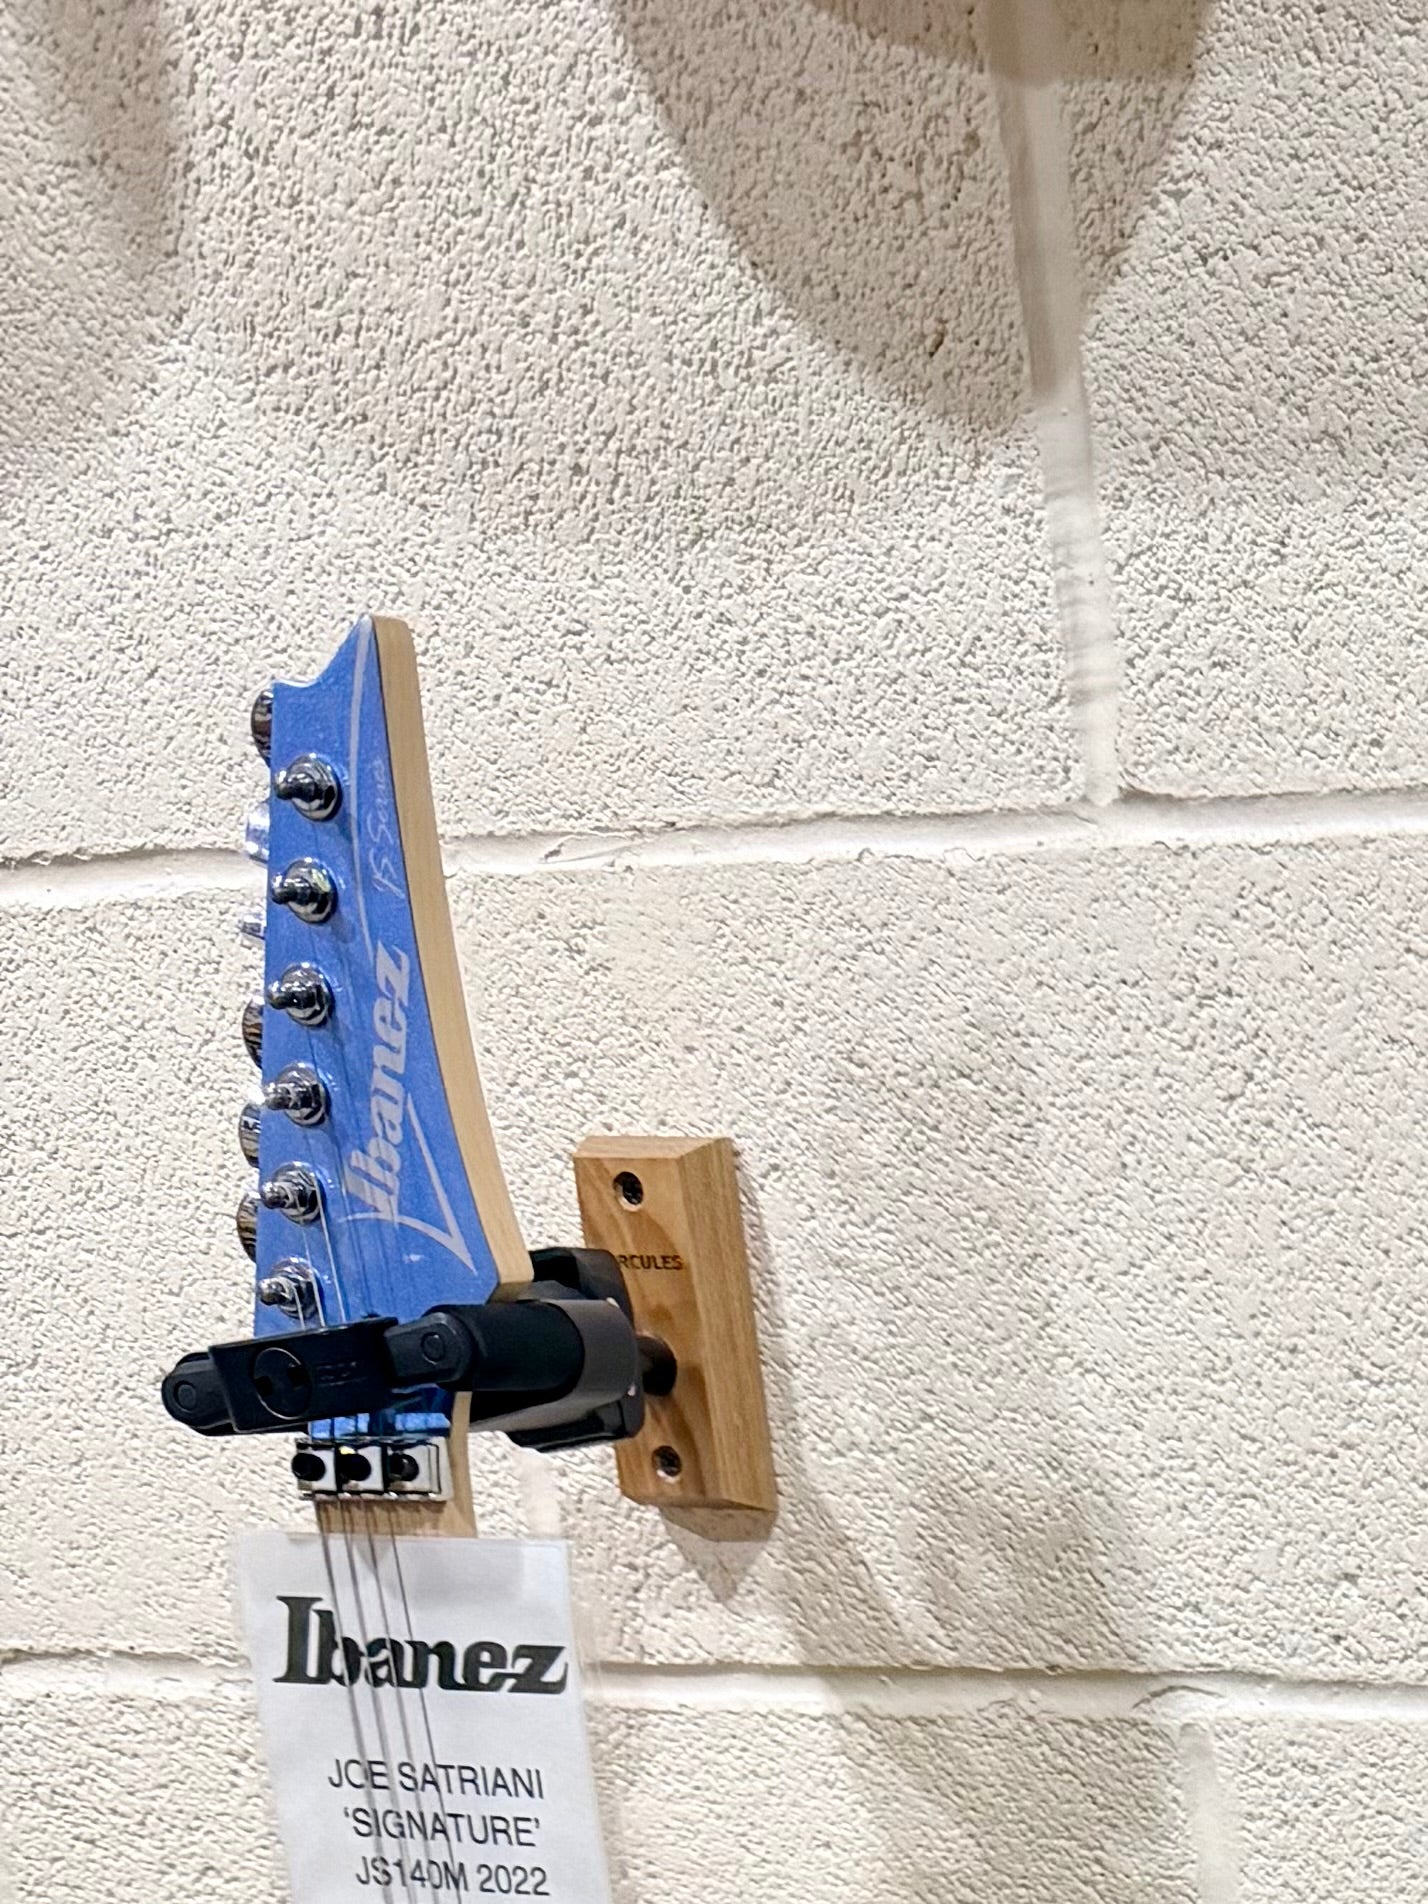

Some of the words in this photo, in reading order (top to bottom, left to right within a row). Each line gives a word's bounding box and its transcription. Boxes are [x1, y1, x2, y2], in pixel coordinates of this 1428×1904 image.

[344, 939, 411, 1228] Ibanez
[617, 1253, 685, 1270] RCULES
[272, 1595, 569, 1694] Ibanez
[328, 1758, 390, 1791] JOE
[397, 1761, 545, 1800] SATRIANI
[355, 1855, 470, 1892] JS140M
[476, 1863, 551, 1897] 2022
